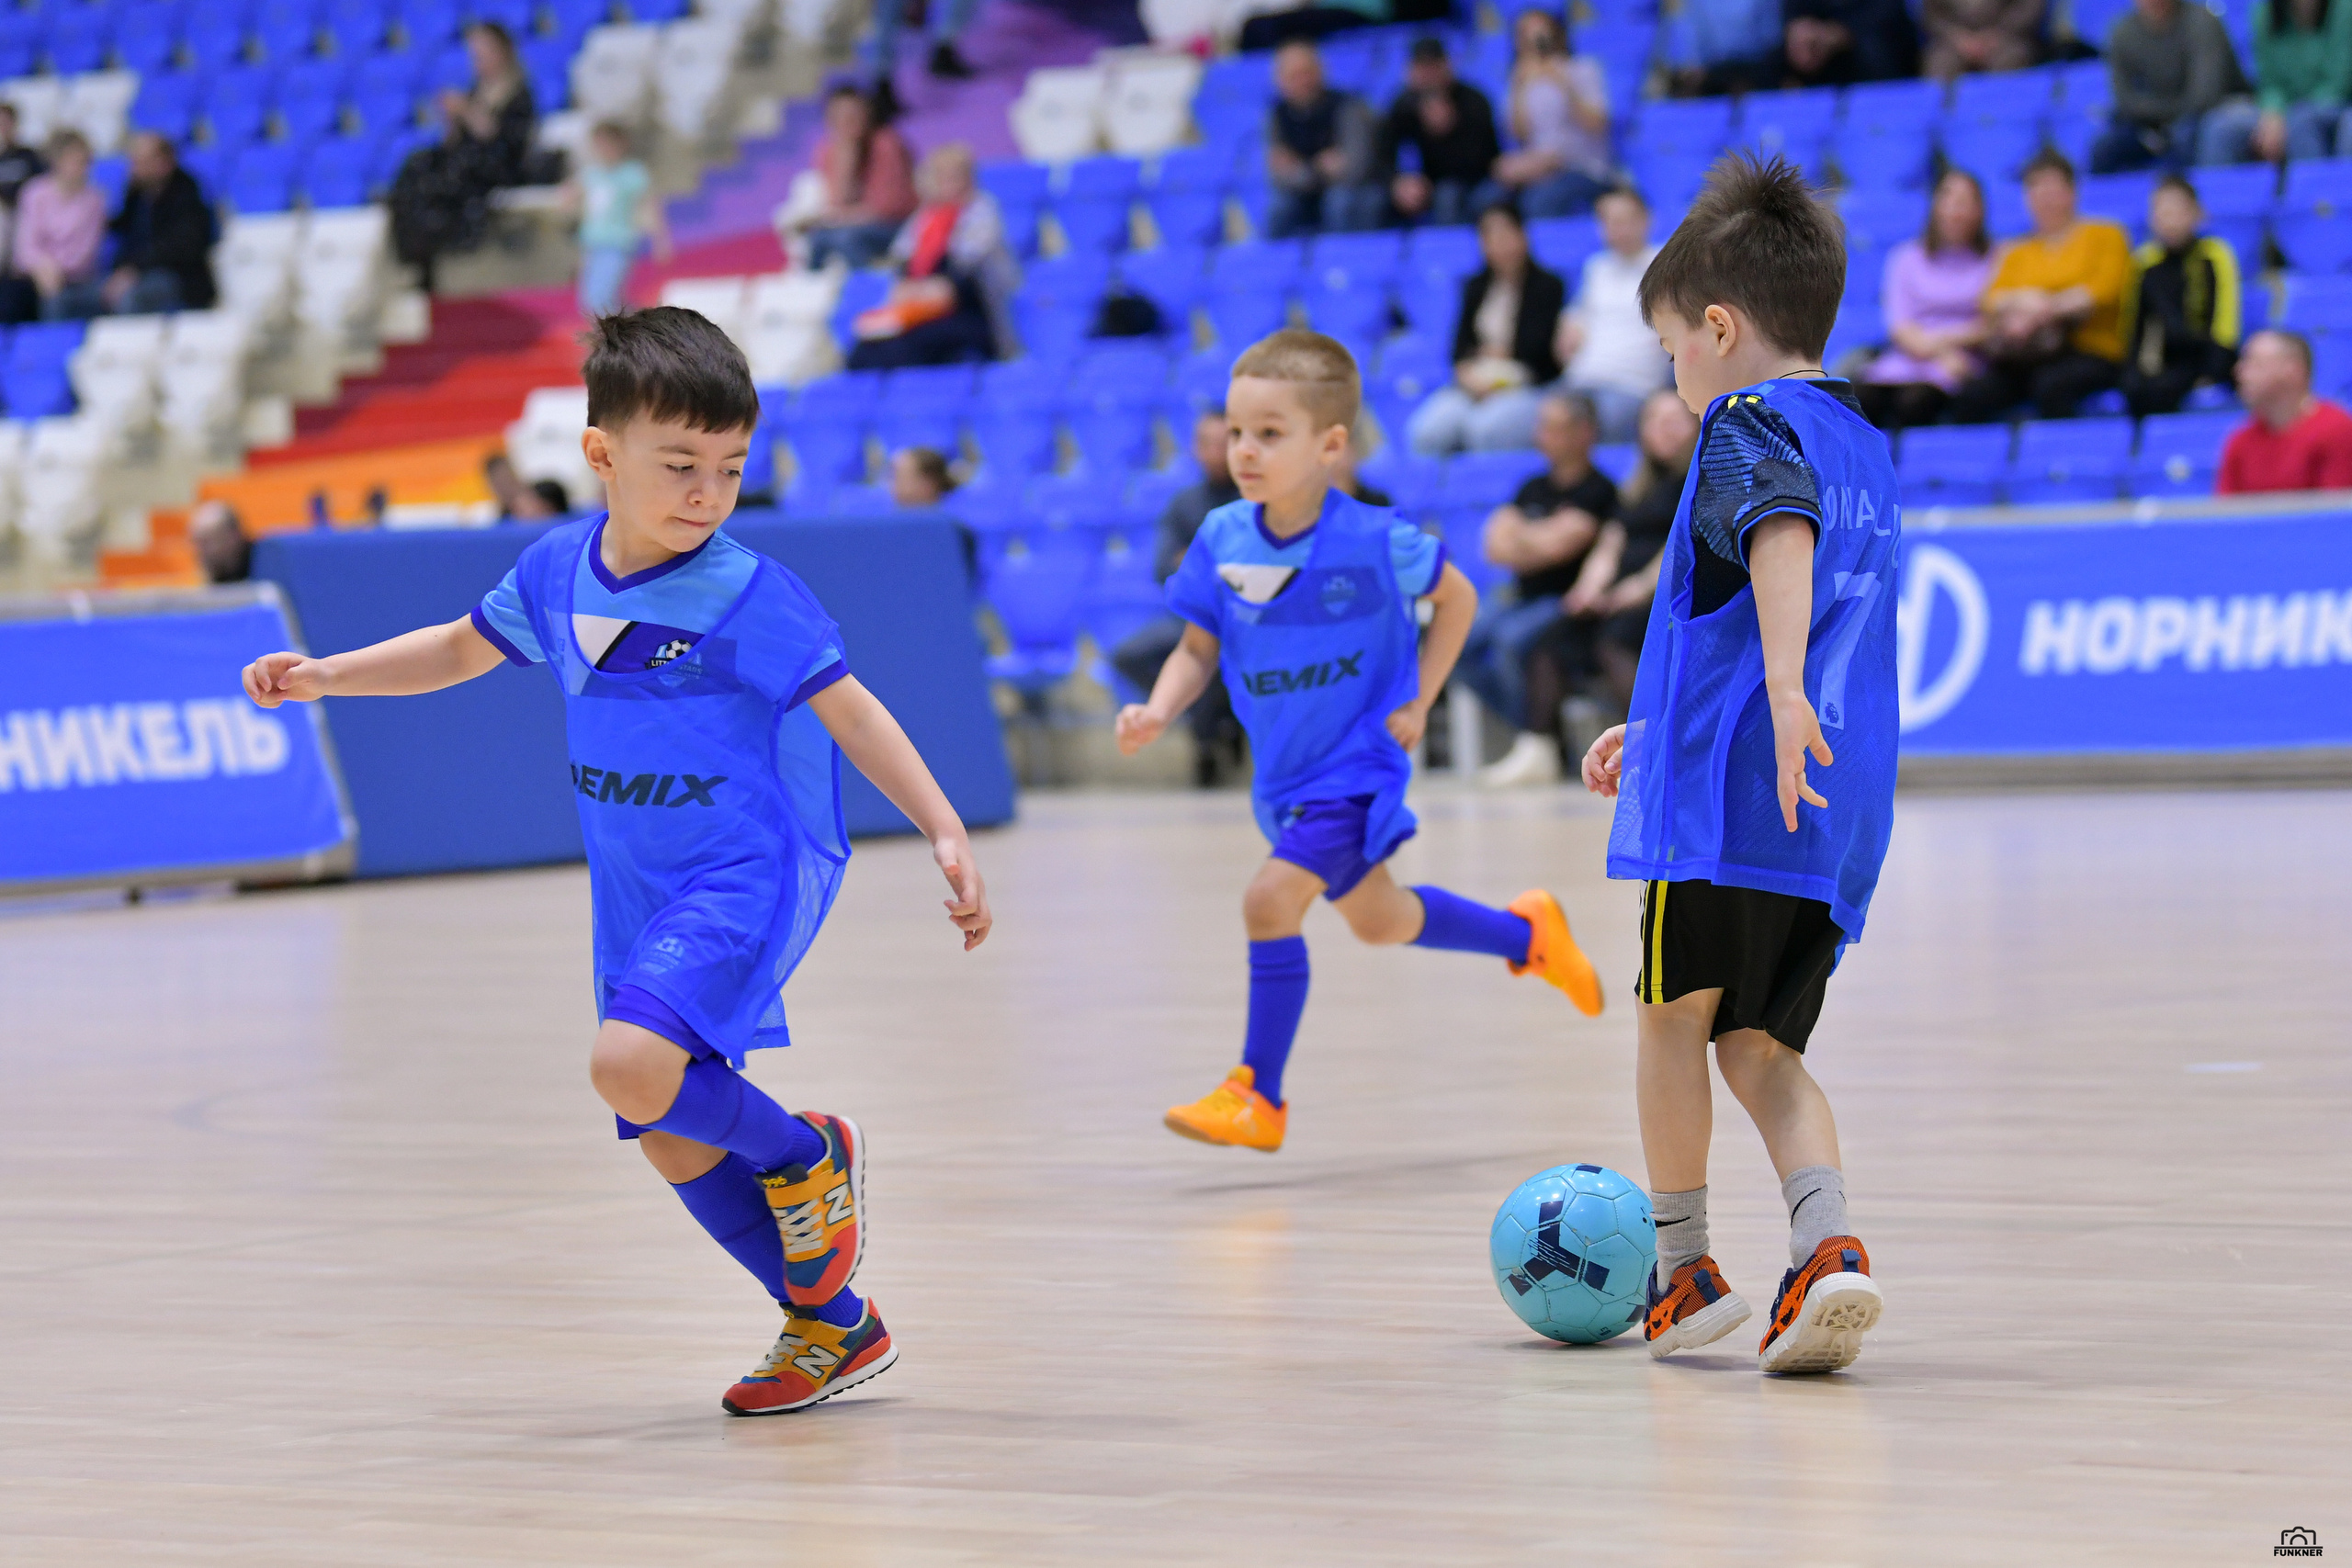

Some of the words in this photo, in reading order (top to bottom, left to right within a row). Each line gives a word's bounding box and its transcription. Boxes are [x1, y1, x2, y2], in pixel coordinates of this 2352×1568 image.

[1823, 485, 1900, 568] ONAL
[1819, 571, 1882, 730] 7
[792, 1344, 841, 1379] N
